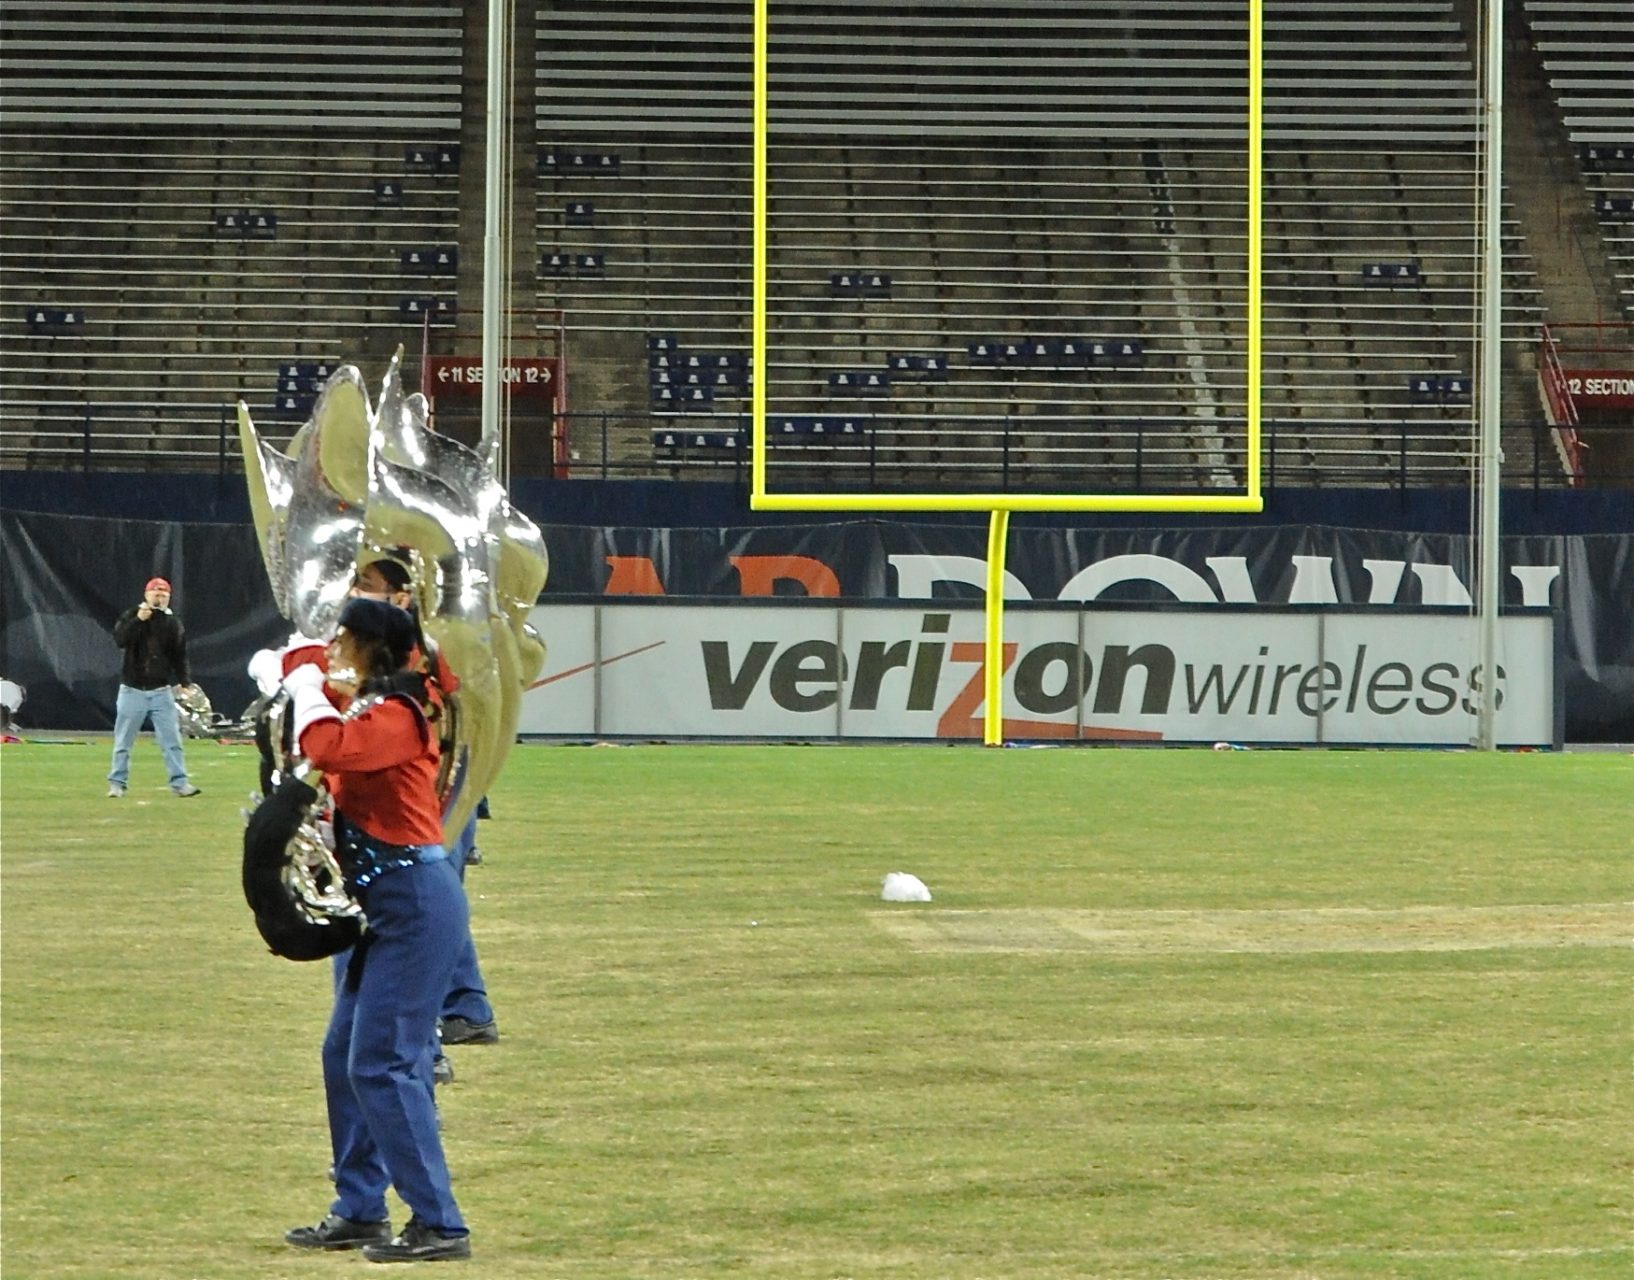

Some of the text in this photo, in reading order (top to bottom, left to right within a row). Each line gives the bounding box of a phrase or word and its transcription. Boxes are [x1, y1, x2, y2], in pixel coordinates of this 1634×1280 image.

[451, 366, 463, 383] 11
[525, 367, 538, 383] 12
[1568, 378, 1582, 395] 12
[701, 613, 1507, 739] verizon wireless
